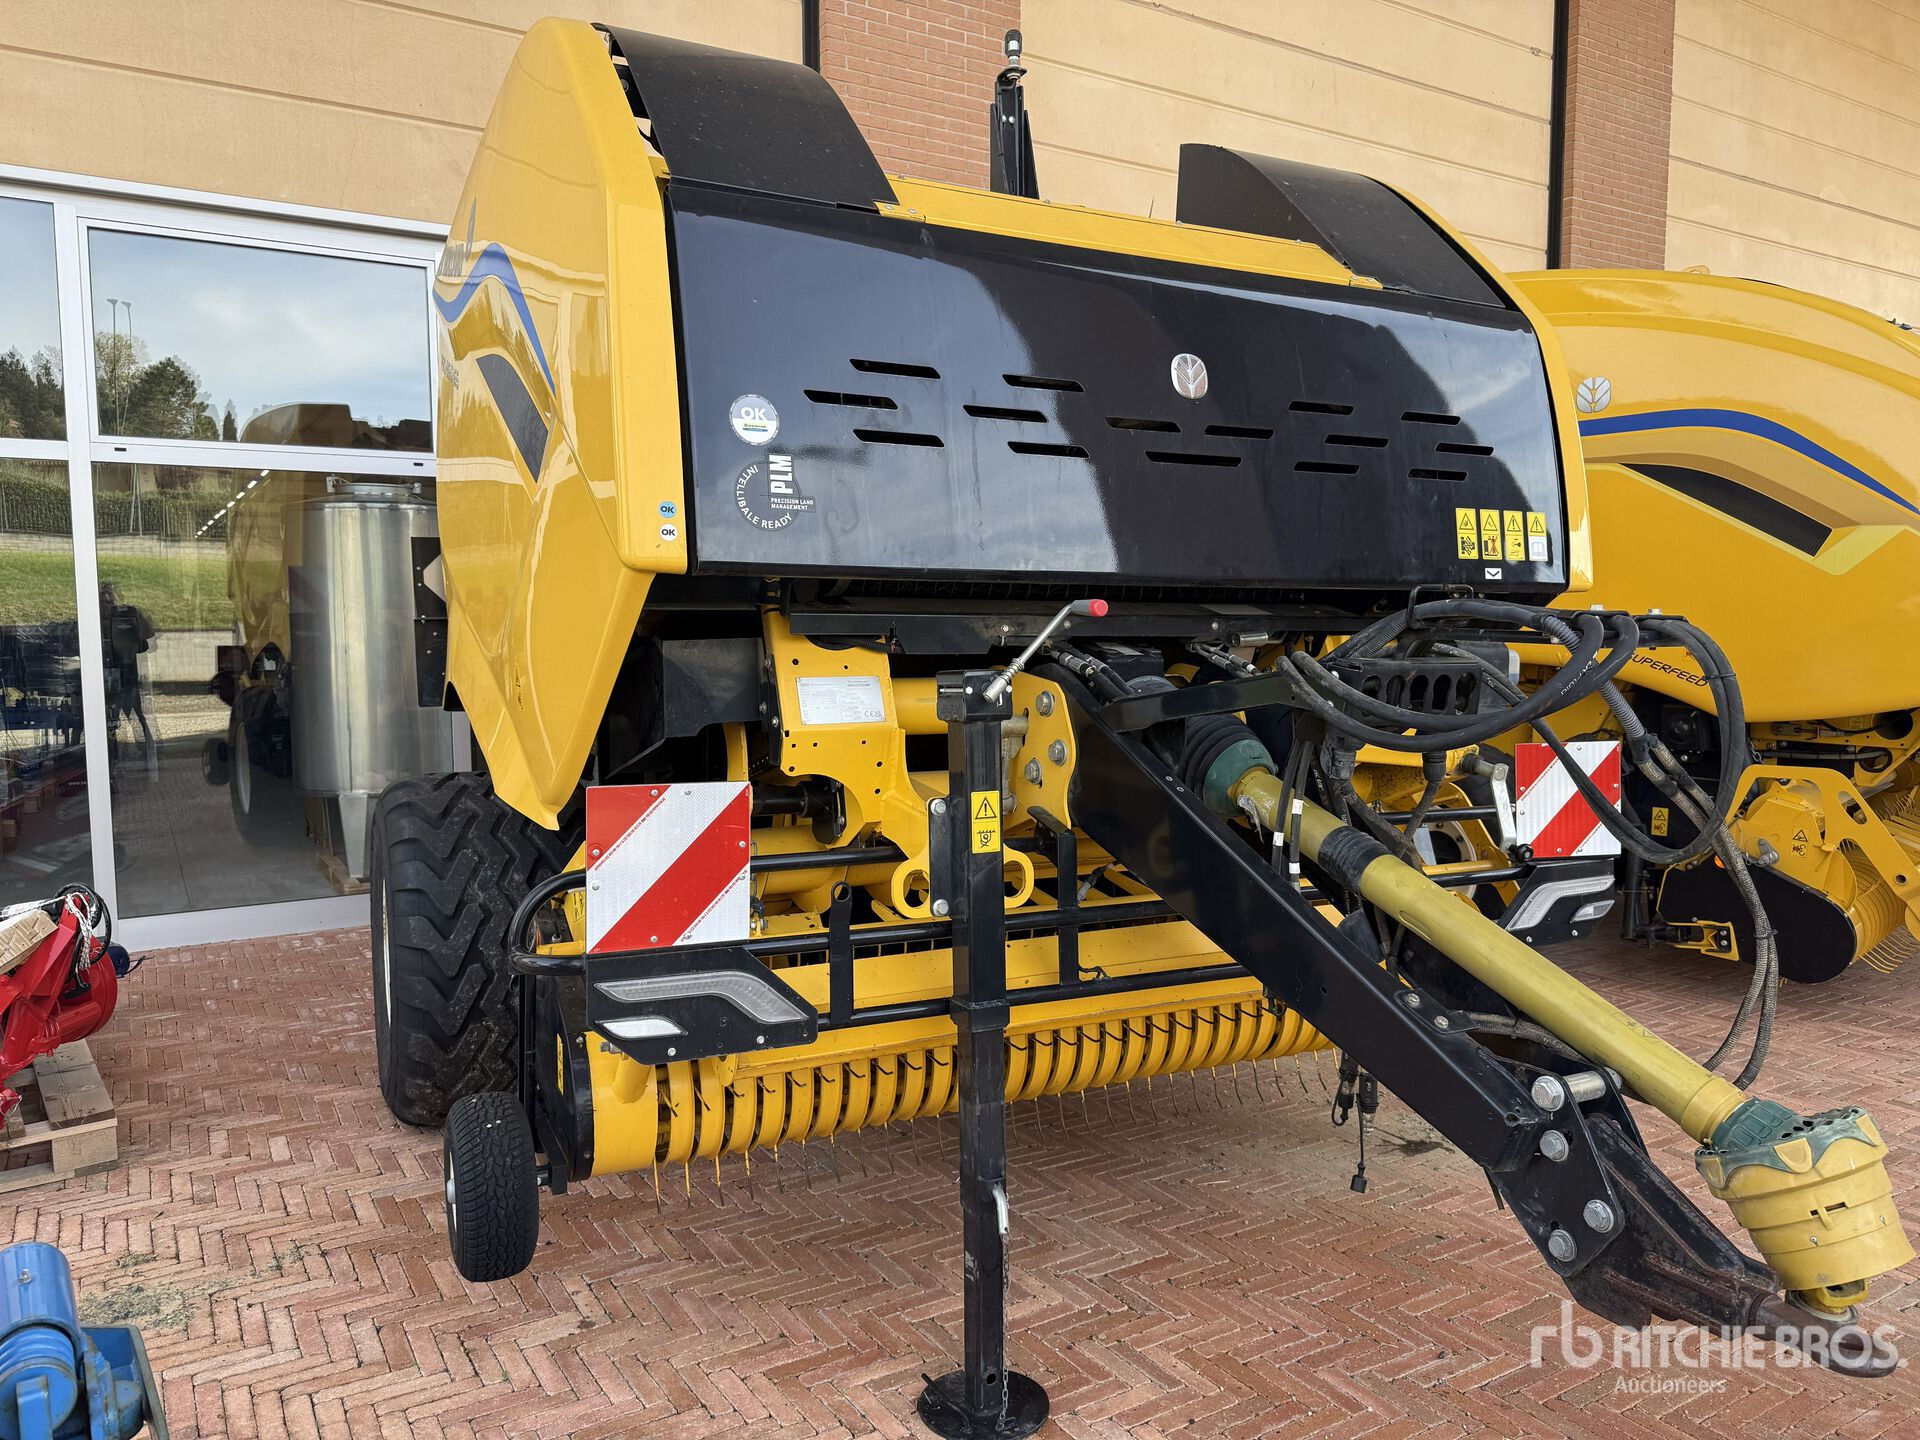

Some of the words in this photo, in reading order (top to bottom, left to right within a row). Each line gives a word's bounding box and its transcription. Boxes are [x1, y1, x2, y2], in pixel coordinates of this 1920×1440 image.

[741, 407, 767, 421] OK
[768, 454, 794, 495] PLM
[736, 464, 760, 525] INTELLIBALE
[761, 512, 792, 529] READY
[660, 505, 675, 514] OK
[770, 503, 808, 511] MANAGEMENT
[661, 528, 676, 537] OK
[1631, 652, 1708, 687] UPERFEED
